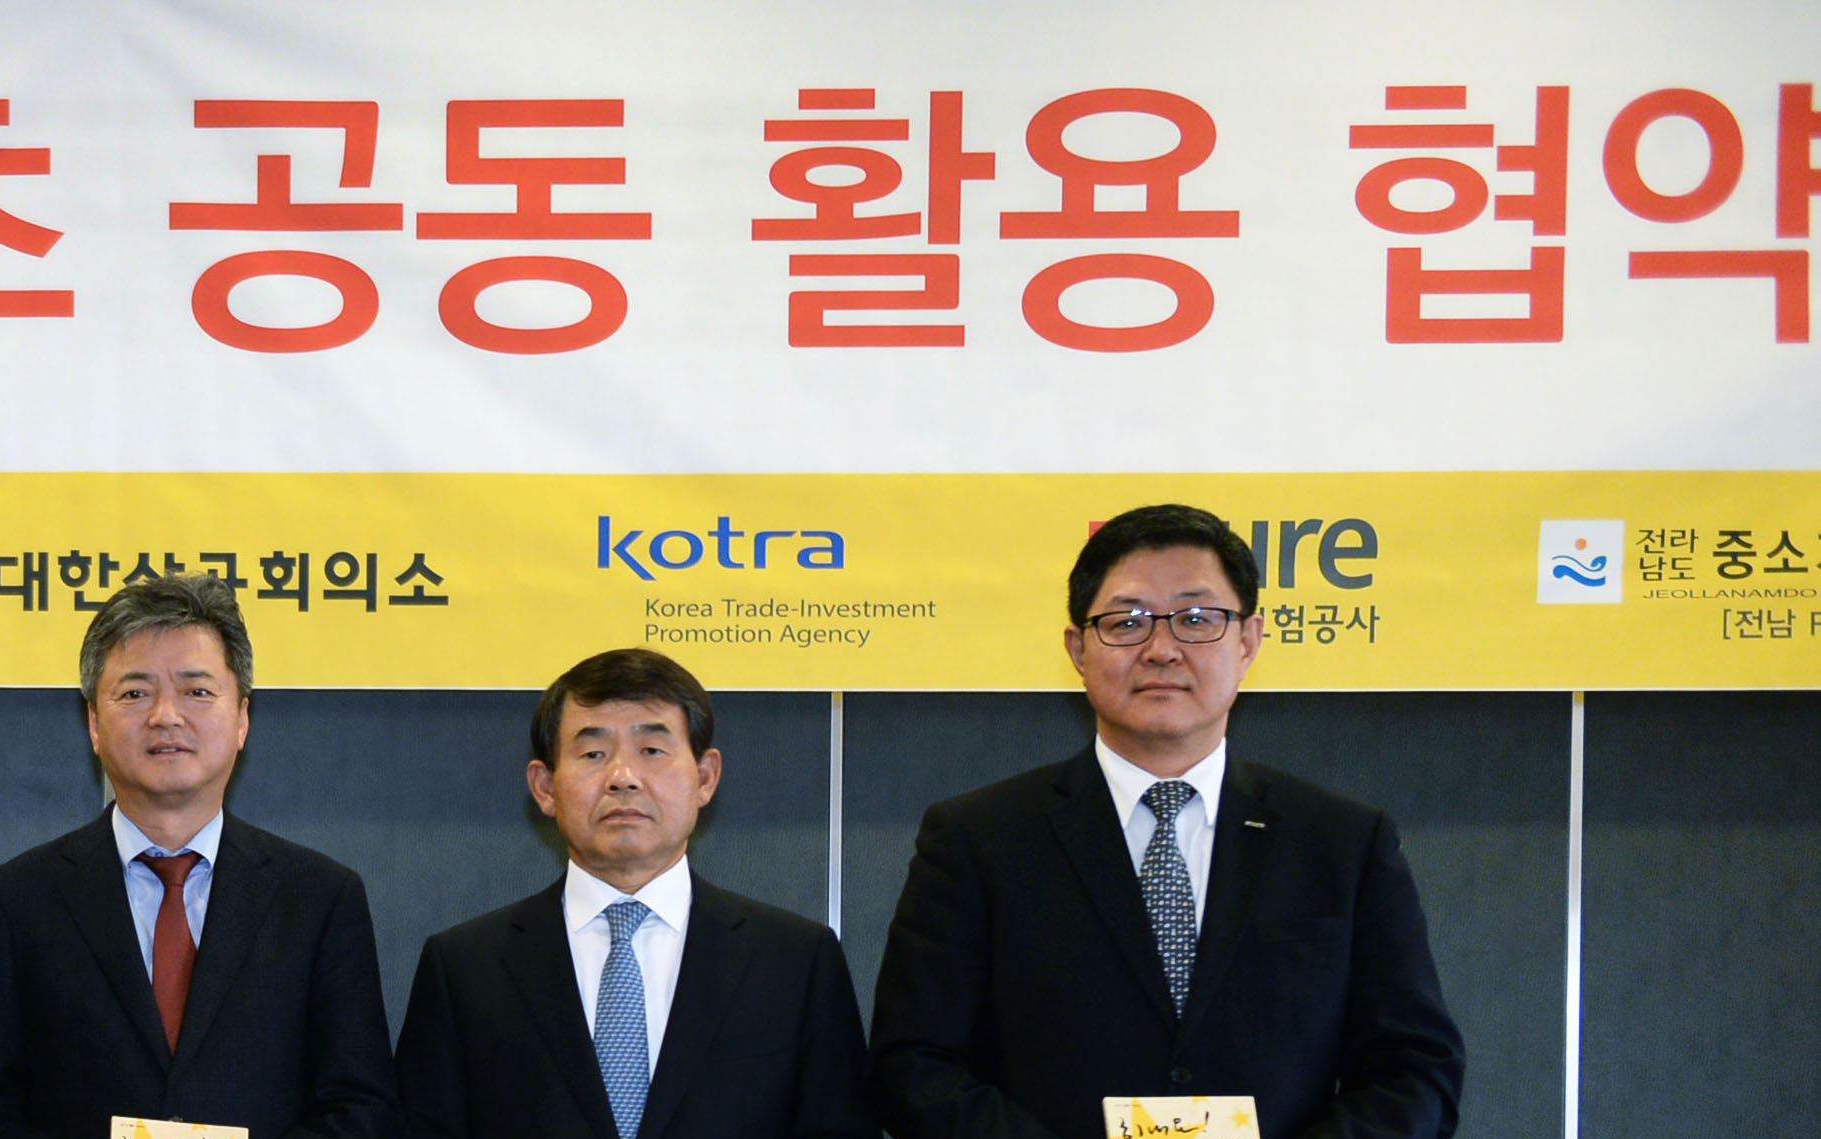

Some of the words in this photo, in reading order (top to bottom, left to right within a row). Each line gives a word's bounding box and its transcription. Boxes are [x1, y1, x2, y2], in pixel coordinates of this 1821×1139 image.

[169, 99, 652, 355] 공동
[751, 87, 1240, 353] 활용
[1349, 83, 1821, 344] 협약
[597, 515, 844, 581] kotra
[1636, 528, 1699, 554] 전라
[1712, 529, 1821, 580] 중소
[1639, 556, 1696, 582] 남도
[1643, 588, 1818, 599] JEOLLANAMDO
[645, 598, 713, 618] Korea
[722, 598, 937, 618] Trade-Investment
[645, 624, 772, 643] Promotion
[779, 624, 871, 648] Agency
[1258, 604, 1381, 645] 험공사
